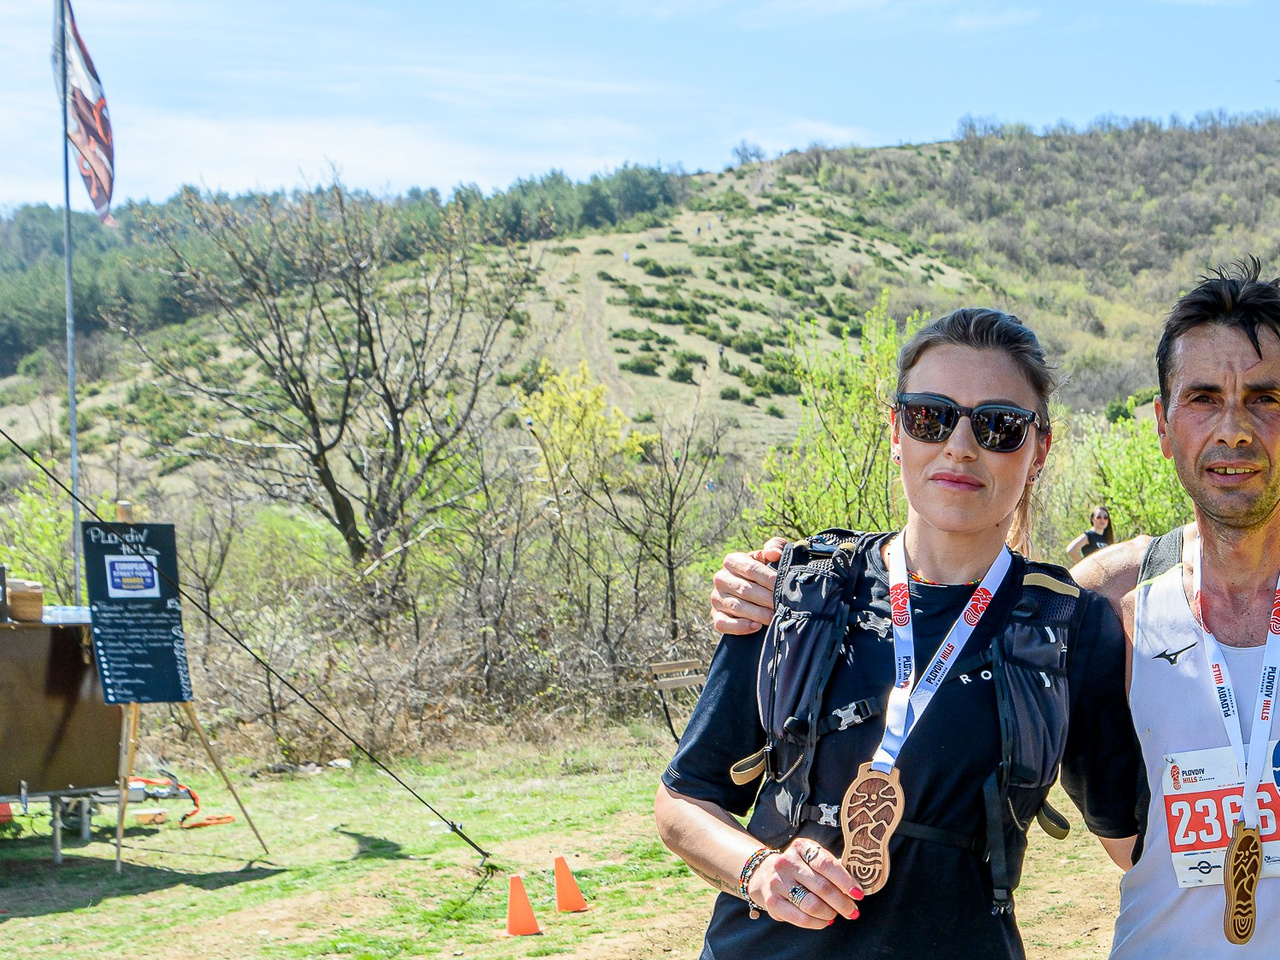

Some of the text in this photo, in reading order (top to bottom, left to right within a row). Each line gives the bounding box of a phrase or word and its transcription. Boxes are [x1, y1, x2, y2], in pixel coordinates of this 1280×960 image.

[925, 643, 955, 685] PLOVDIV HILLS
[1212, 663, 1231, 718] PLOVDIV HILLS
[1261, 666, 1277, 721] PLOVDIV HILLS
[1181, 768, 1205, 777] PLOVDIV
[1182, 776, 1198, 784] HILLS
[1170, 791, 1277, 846] 2366
